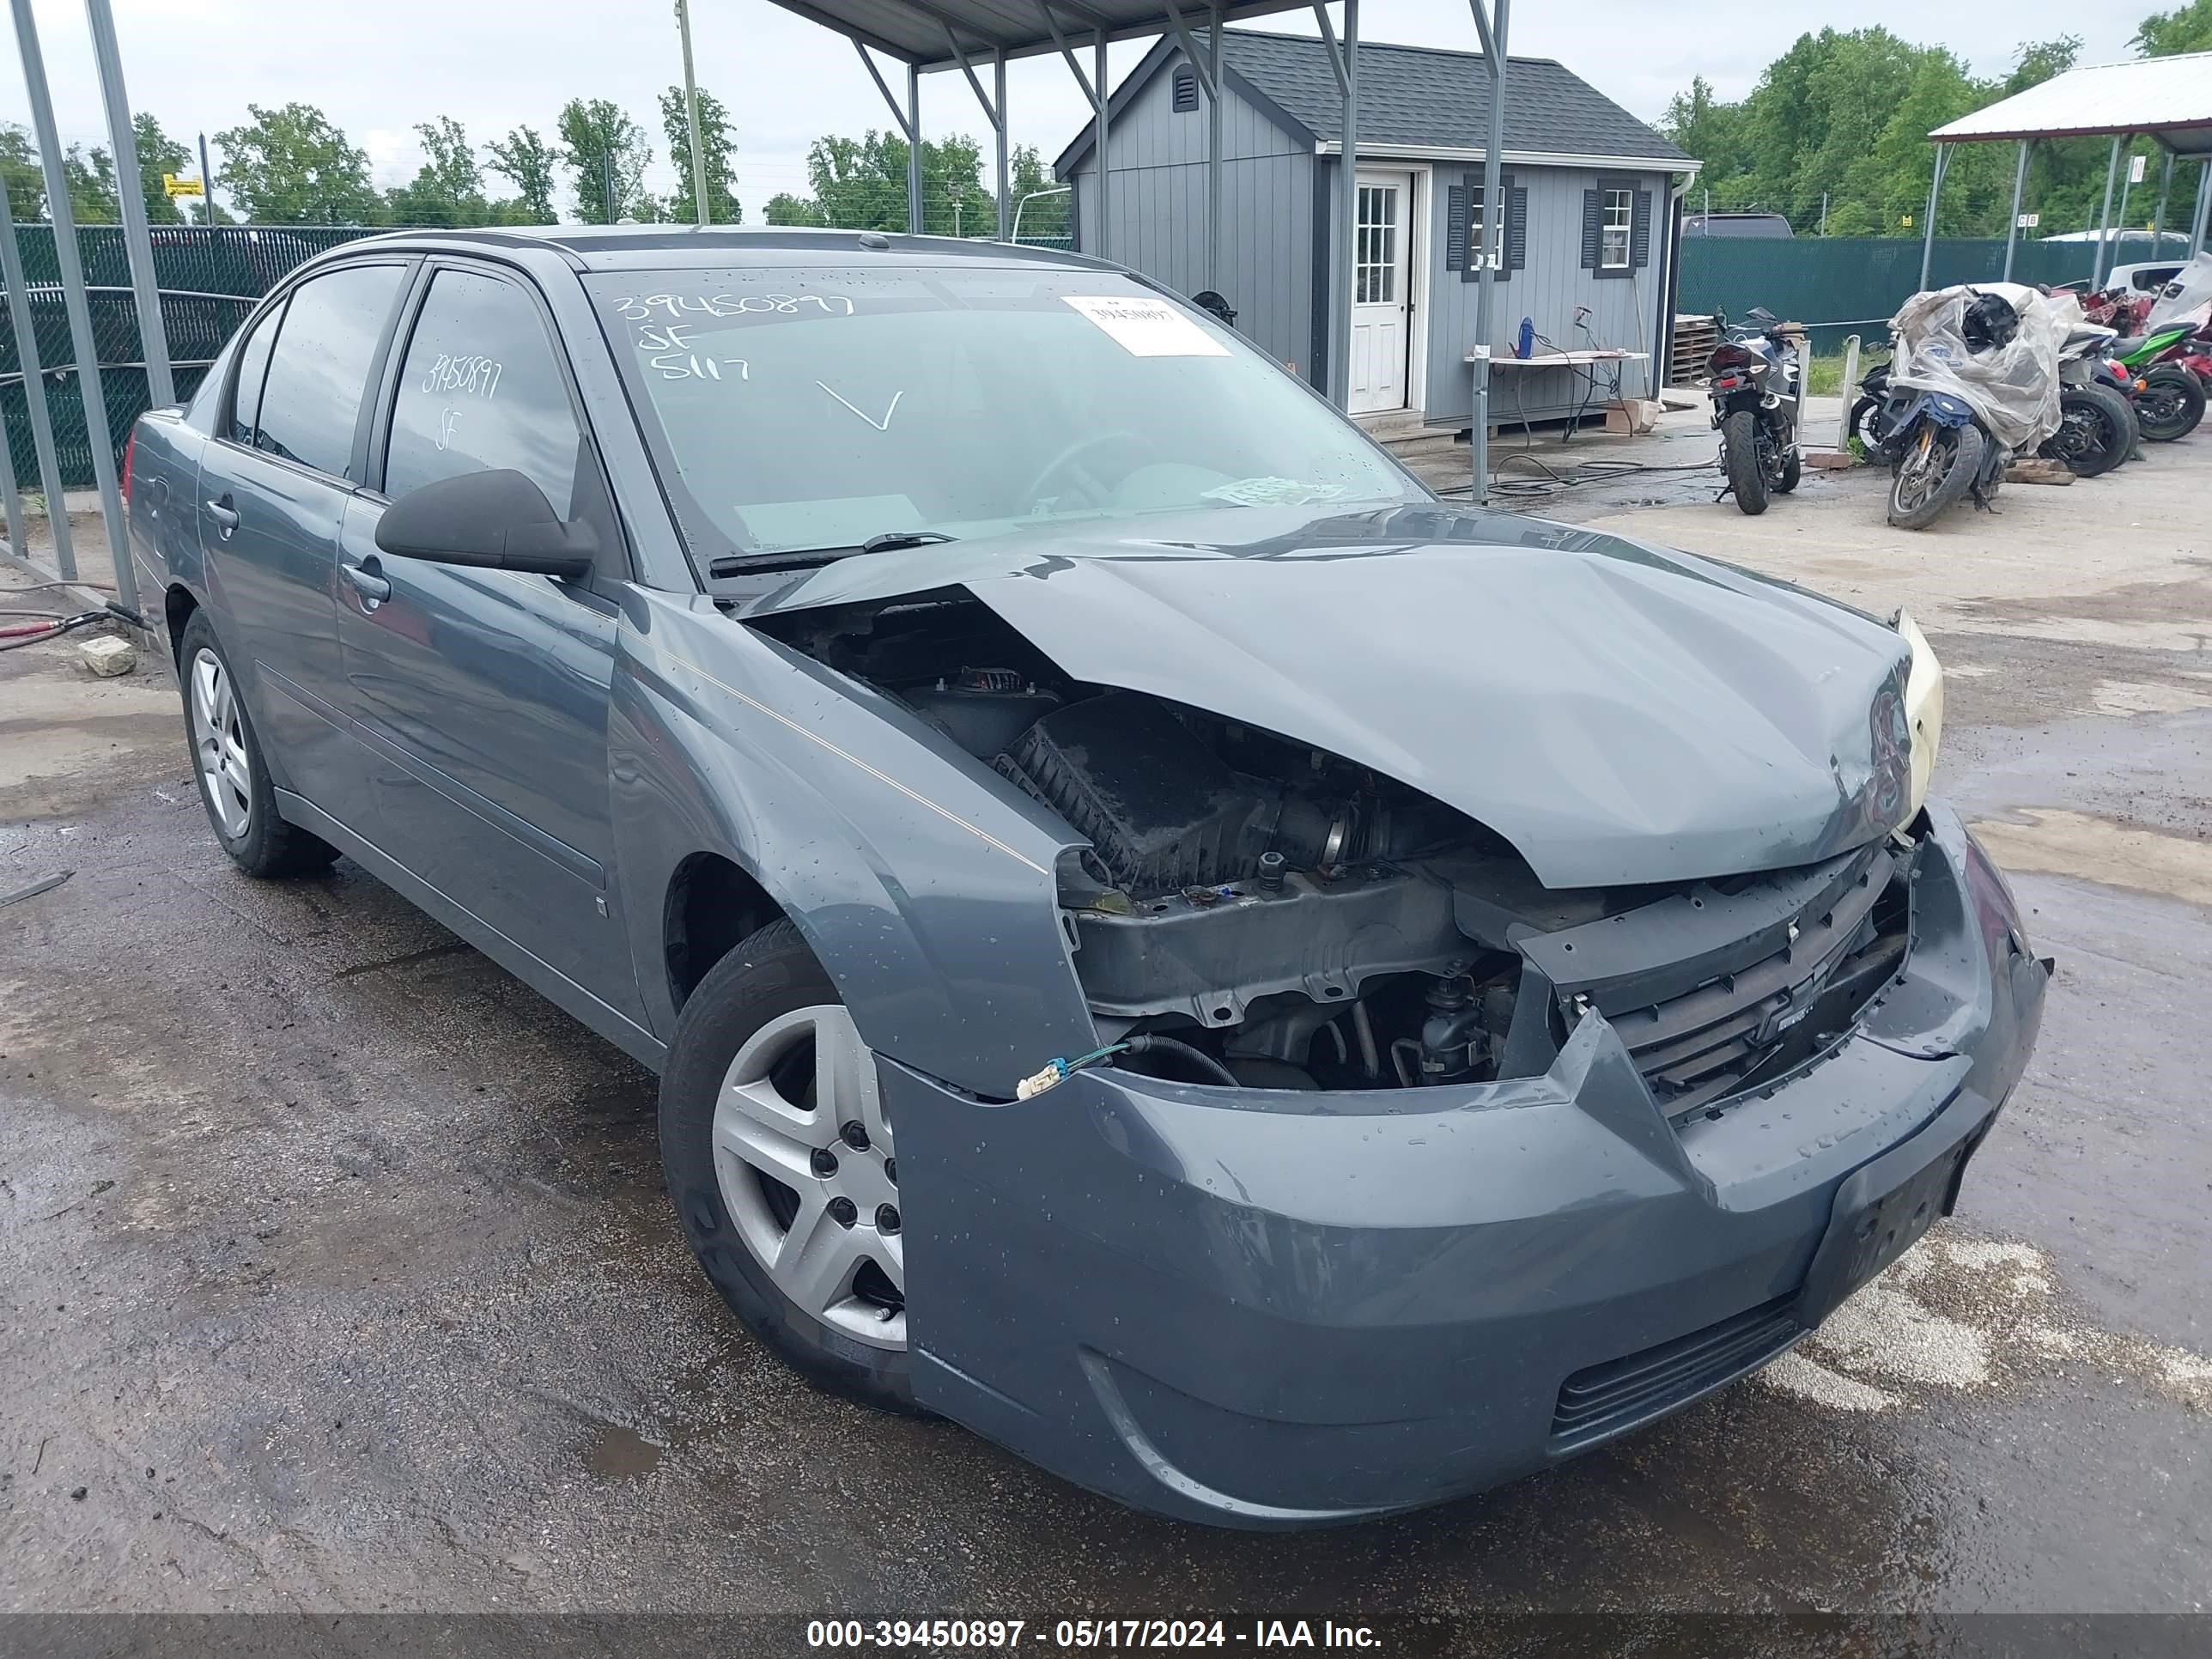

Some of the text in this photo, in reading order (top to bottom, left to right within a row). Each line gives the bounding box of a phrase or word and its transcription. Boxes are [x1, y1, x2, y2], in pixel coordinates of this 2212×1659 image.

[613, 294, 854, 320] 39450897
[638, 324, 702, 351] SF
[422, 353, 502, 401] 39450897
[435, 407, 463, 451] SF
